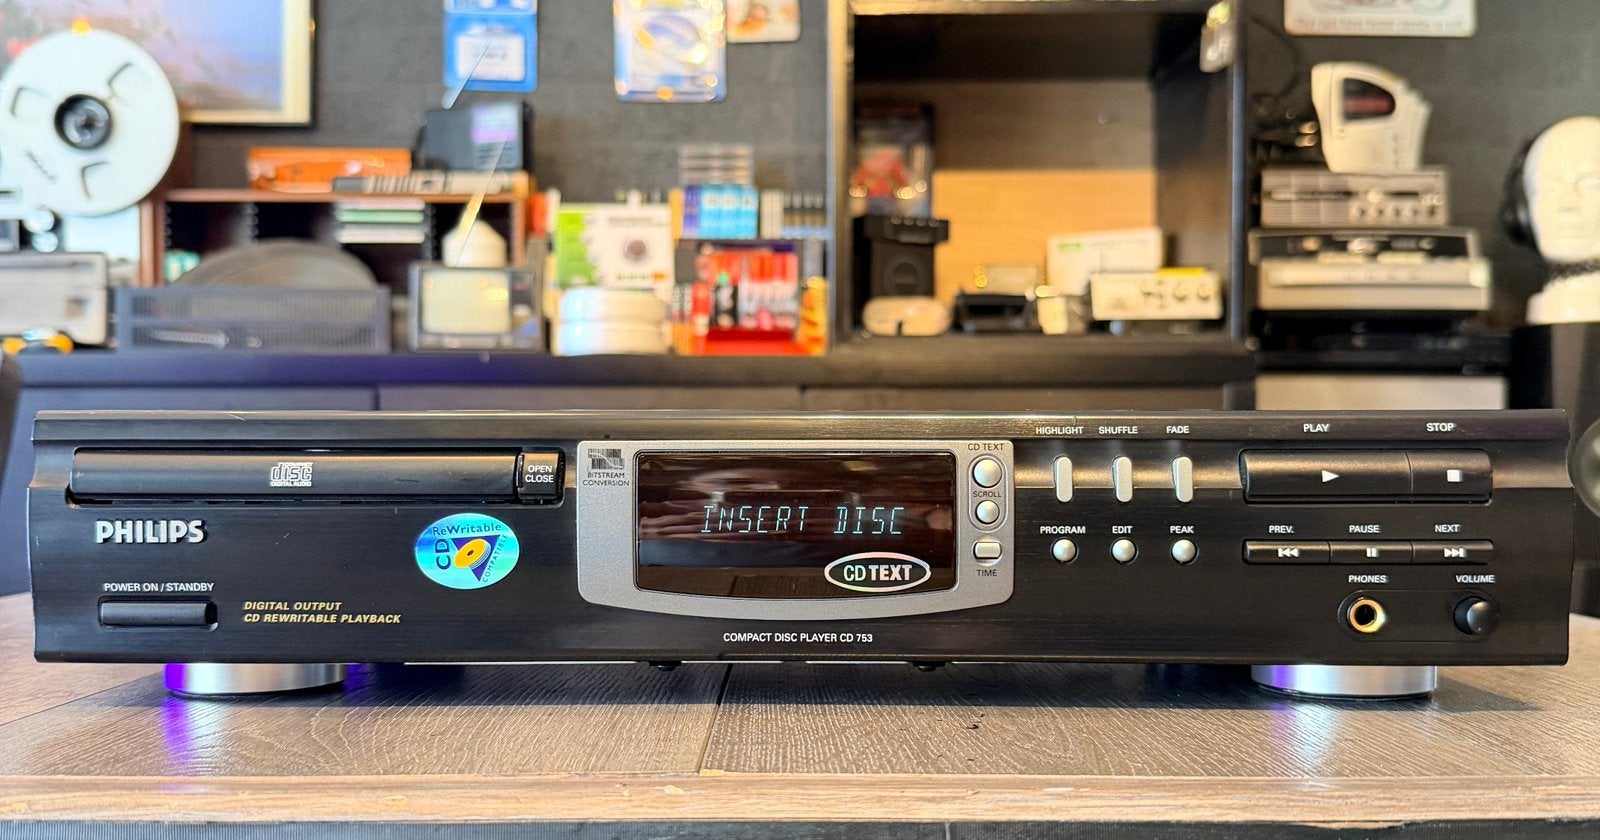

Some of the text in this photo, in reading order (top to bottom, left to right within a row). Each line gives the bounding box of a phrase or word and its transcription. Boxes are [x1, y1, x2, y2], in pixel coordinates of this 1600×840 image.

[1035, 426, 1084, 435] HIGHLIGHT
[1098, 426, 1138, 434] SHUFFLE
[1166, 425, 1190, 434] FADE
[1303, 423, 1330, 433] PLAY
[1426, 422, 1455, 432] STOP
[967, 442, 1004, 451] CD TEXT
[527, 465, 553, 473] OPEN
[525, 474, 554, 483] CLOSE
[582, 479, 630, 487] CONVERSION
[972, 490, 1002, 498] SCROLL
[701, 505, 904, 534] INSERT DISC
[95, 520, 205, 543] PHILIPS
[432, 523, 502, 536] ReWritable
[1040, 526, 1086, 535] PROGRAM
[1112, 526, 1133, 534] EDIT
[1170, 525, 1195, 534] PEAK
[1268, 525, 1294, 534] PREV.
[1349, 525, 1381, 534] PAUSE
[1434, 524, 1461, 533] NEXT
[434, 538, 452, 570] CD
[482, 534, 508, 583] COMPATIBLE
[843, 564, 913, 581] CD TEXT
[976, 568, 998, 577] TIME
[1348, 574, 1388, 583] PHONES
[1455, 574, 1496, 583] VOLUME
[104, 583, 141, 592] POWER
[143, 583, 158, 592] ON
[166, 583, 215, 592] STANDBY
[244, 601, 342, 611] DIGITAL OUTPUT
[244, 613, 401, 624] CD REWRITABLE PLAYBACK
[723, 632, 873, 642] COMPACT DISC PLAYER CD 753
